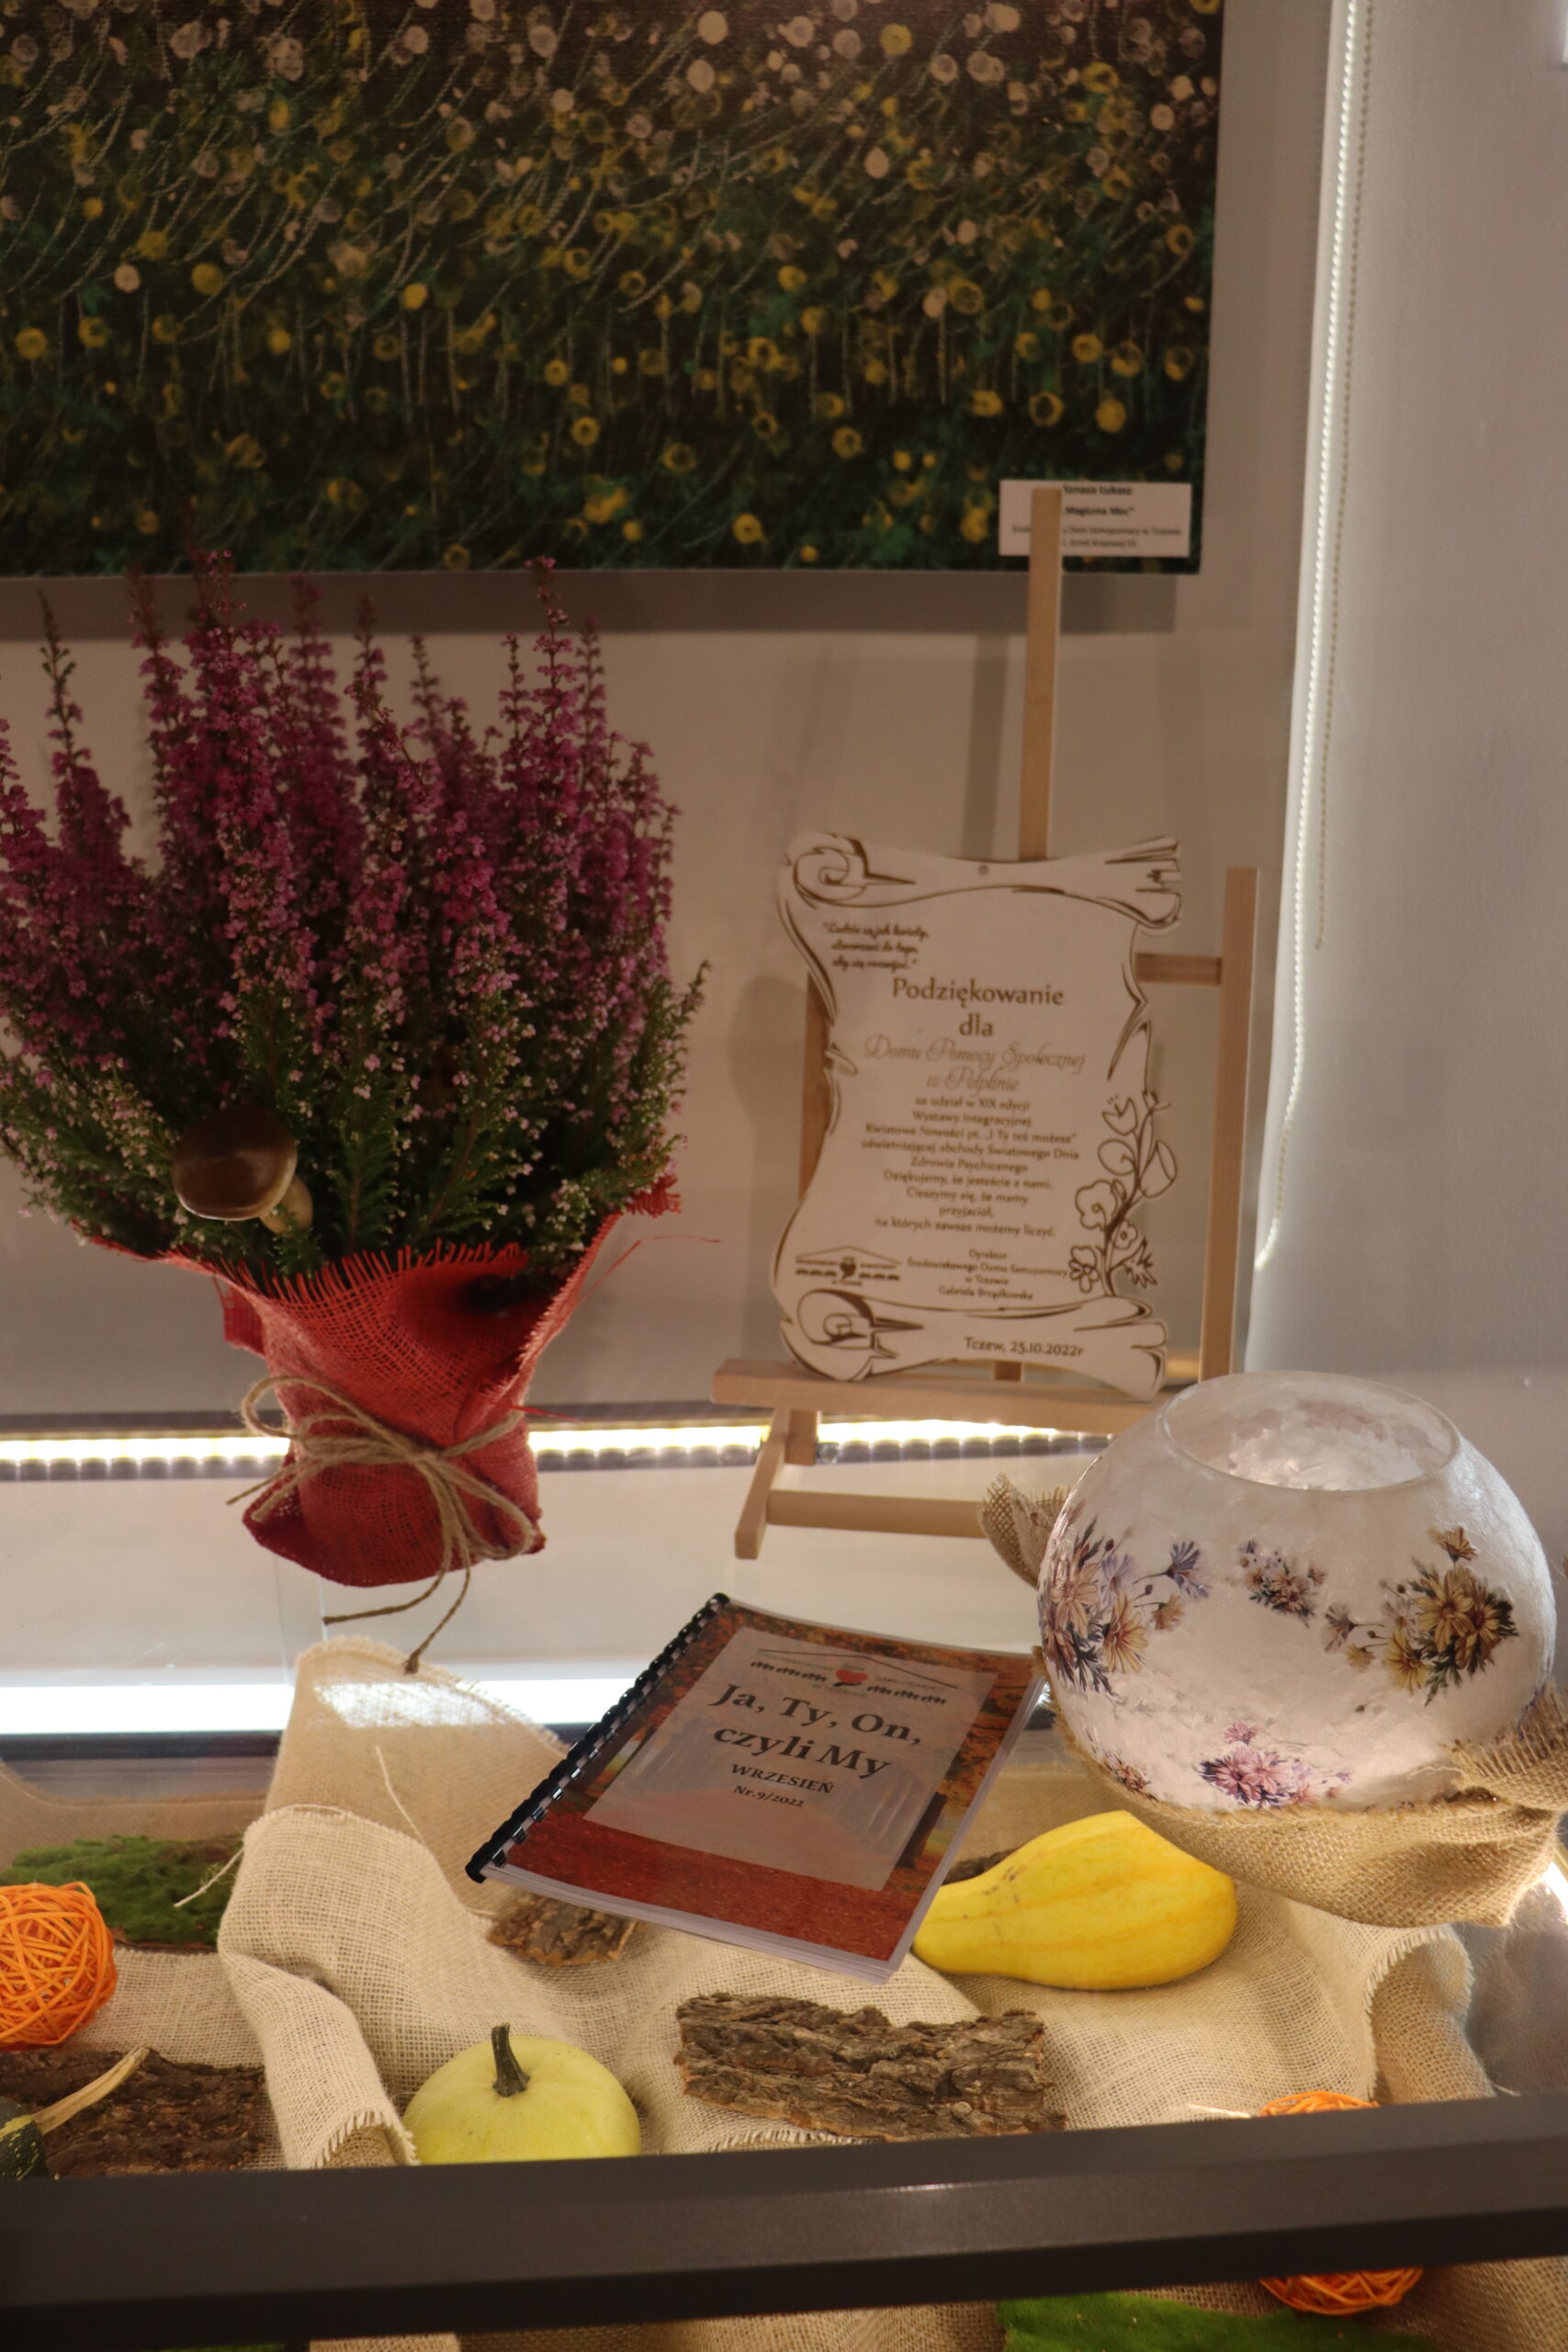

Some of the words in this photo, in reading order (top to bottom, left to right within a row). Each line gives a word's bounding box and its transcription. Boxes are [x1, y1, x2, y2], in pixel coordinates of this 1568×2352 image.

[892, 977, 1065, 1009] Podziękowanie
[958, 1012, 994, 1037] dla
[863, 1035, 920, 1059] Domu
[926, 1037, 998, 1071] Pomocy
[978, 1098, 996, 1109] XIX
[998, 1099, 1031, 1113] edycji
[912, 1110, 960, 1125] Wystawy
[998, 1129, 1009, 1142] Ty
[939, 1142, 984, 1156] obchody
[1054, 1148, 1079, 1160] Dnia
[910, 1156, 953, 1170] Zdrowia
[957, 1159, 1028, 1176] Psychicznego
[952, 1175, 963, 1185] że
[966, 1175, 1010, 1189] jesteście
[906, 1187, 957, 1202] Cieszymy
[981, 1192, 992, 1203] że
[995, 1194, 1029, 1206] mamy
[939, 1204, 994, 1219] przyjaciół,
[874, 1218, 887, 1227] na
[891, 1216, 931, 1232] których
[935, 1222, 972, 1233] zawsze
[976, 1222, 1021, 1237] możemy
[964, 1336, 1006, 1353] Tczew,
[1010, 1340, 1085, 1357] 25.10.2022r
[707, 1683, 765, 1713] Ja,
[780, 1697, 838, 1729] Ty,
[851, 1713, 922, 1746] On,
[713, 1727, 816, 1761] czyli
[816, 1744, 891, 1780] My
[731, 1763, 834, 1794] WRZESIEŃ
